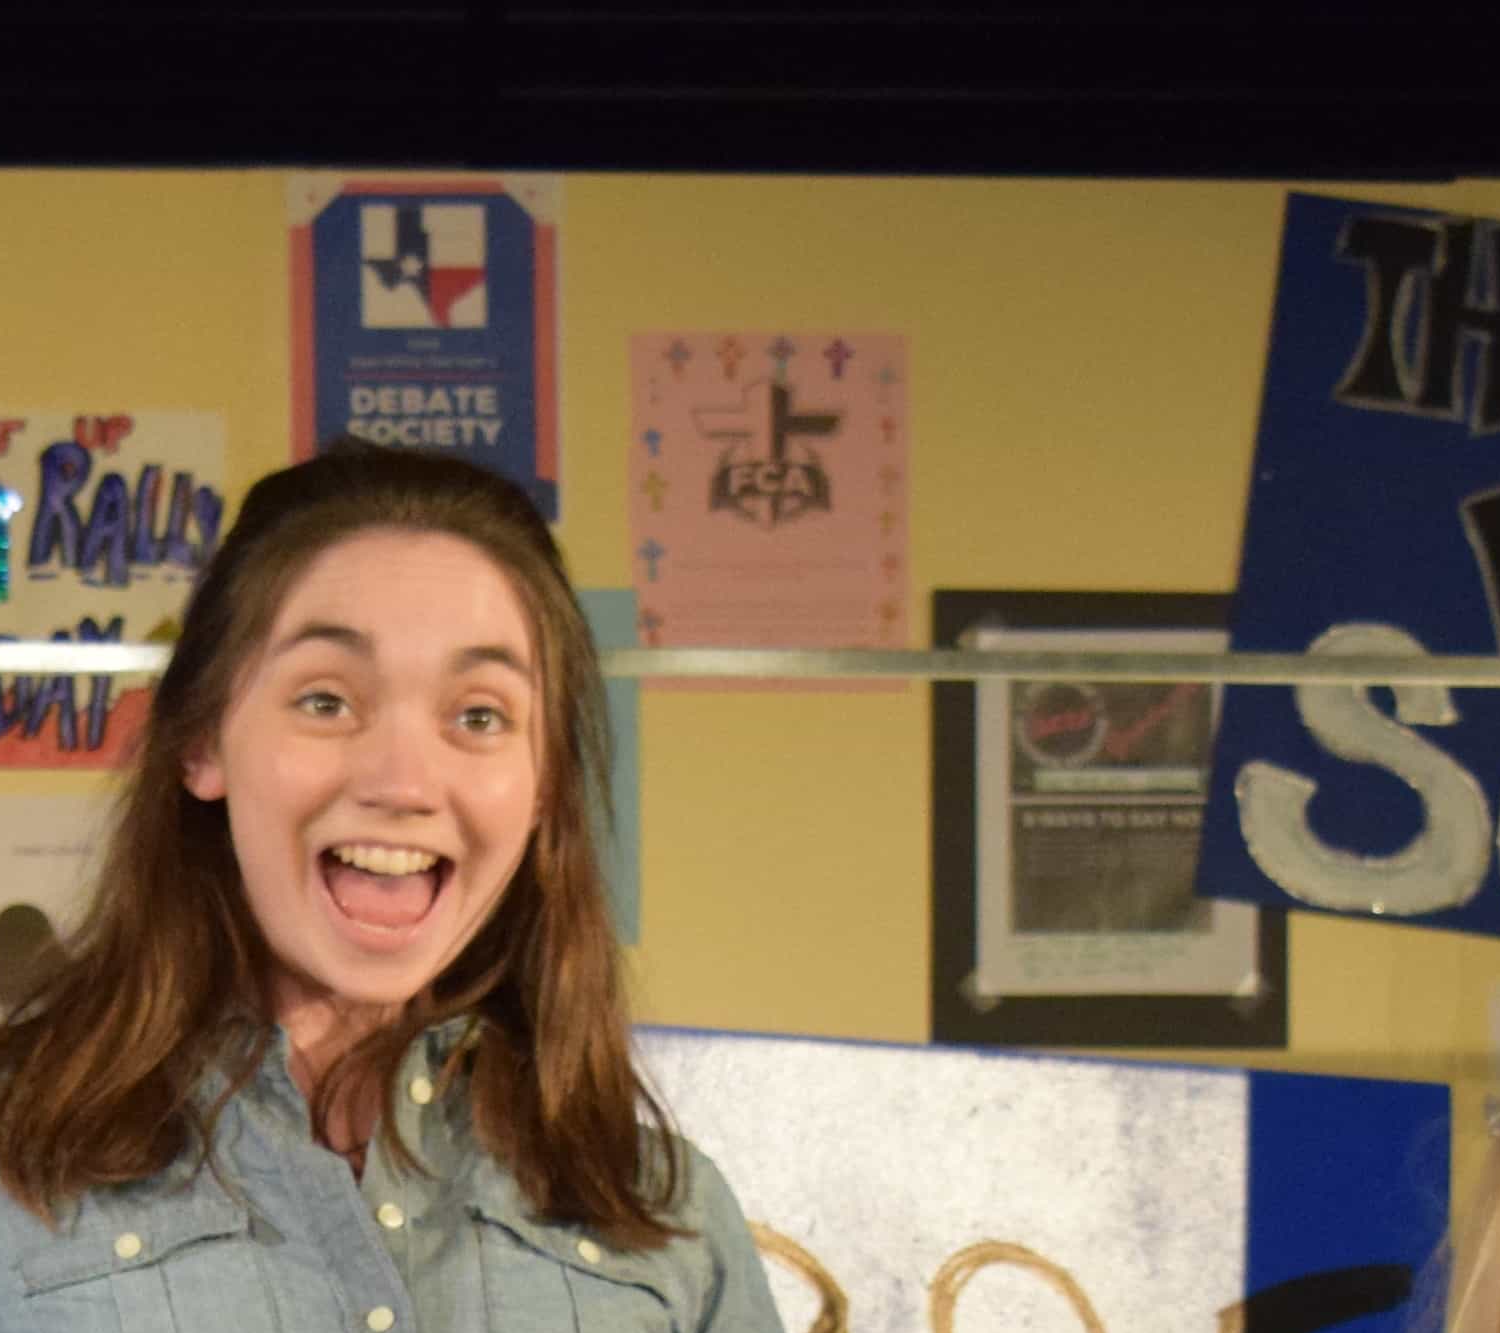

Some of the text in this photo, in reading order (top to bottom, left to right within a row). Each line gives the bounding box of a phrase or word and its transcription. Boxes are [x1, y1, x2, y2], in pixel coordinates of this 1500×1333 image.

[349, 385, 498, 415] DEBATE
[346, 417, 503, 447] SOCIETY
[729, 464, 810, 494] FCA
